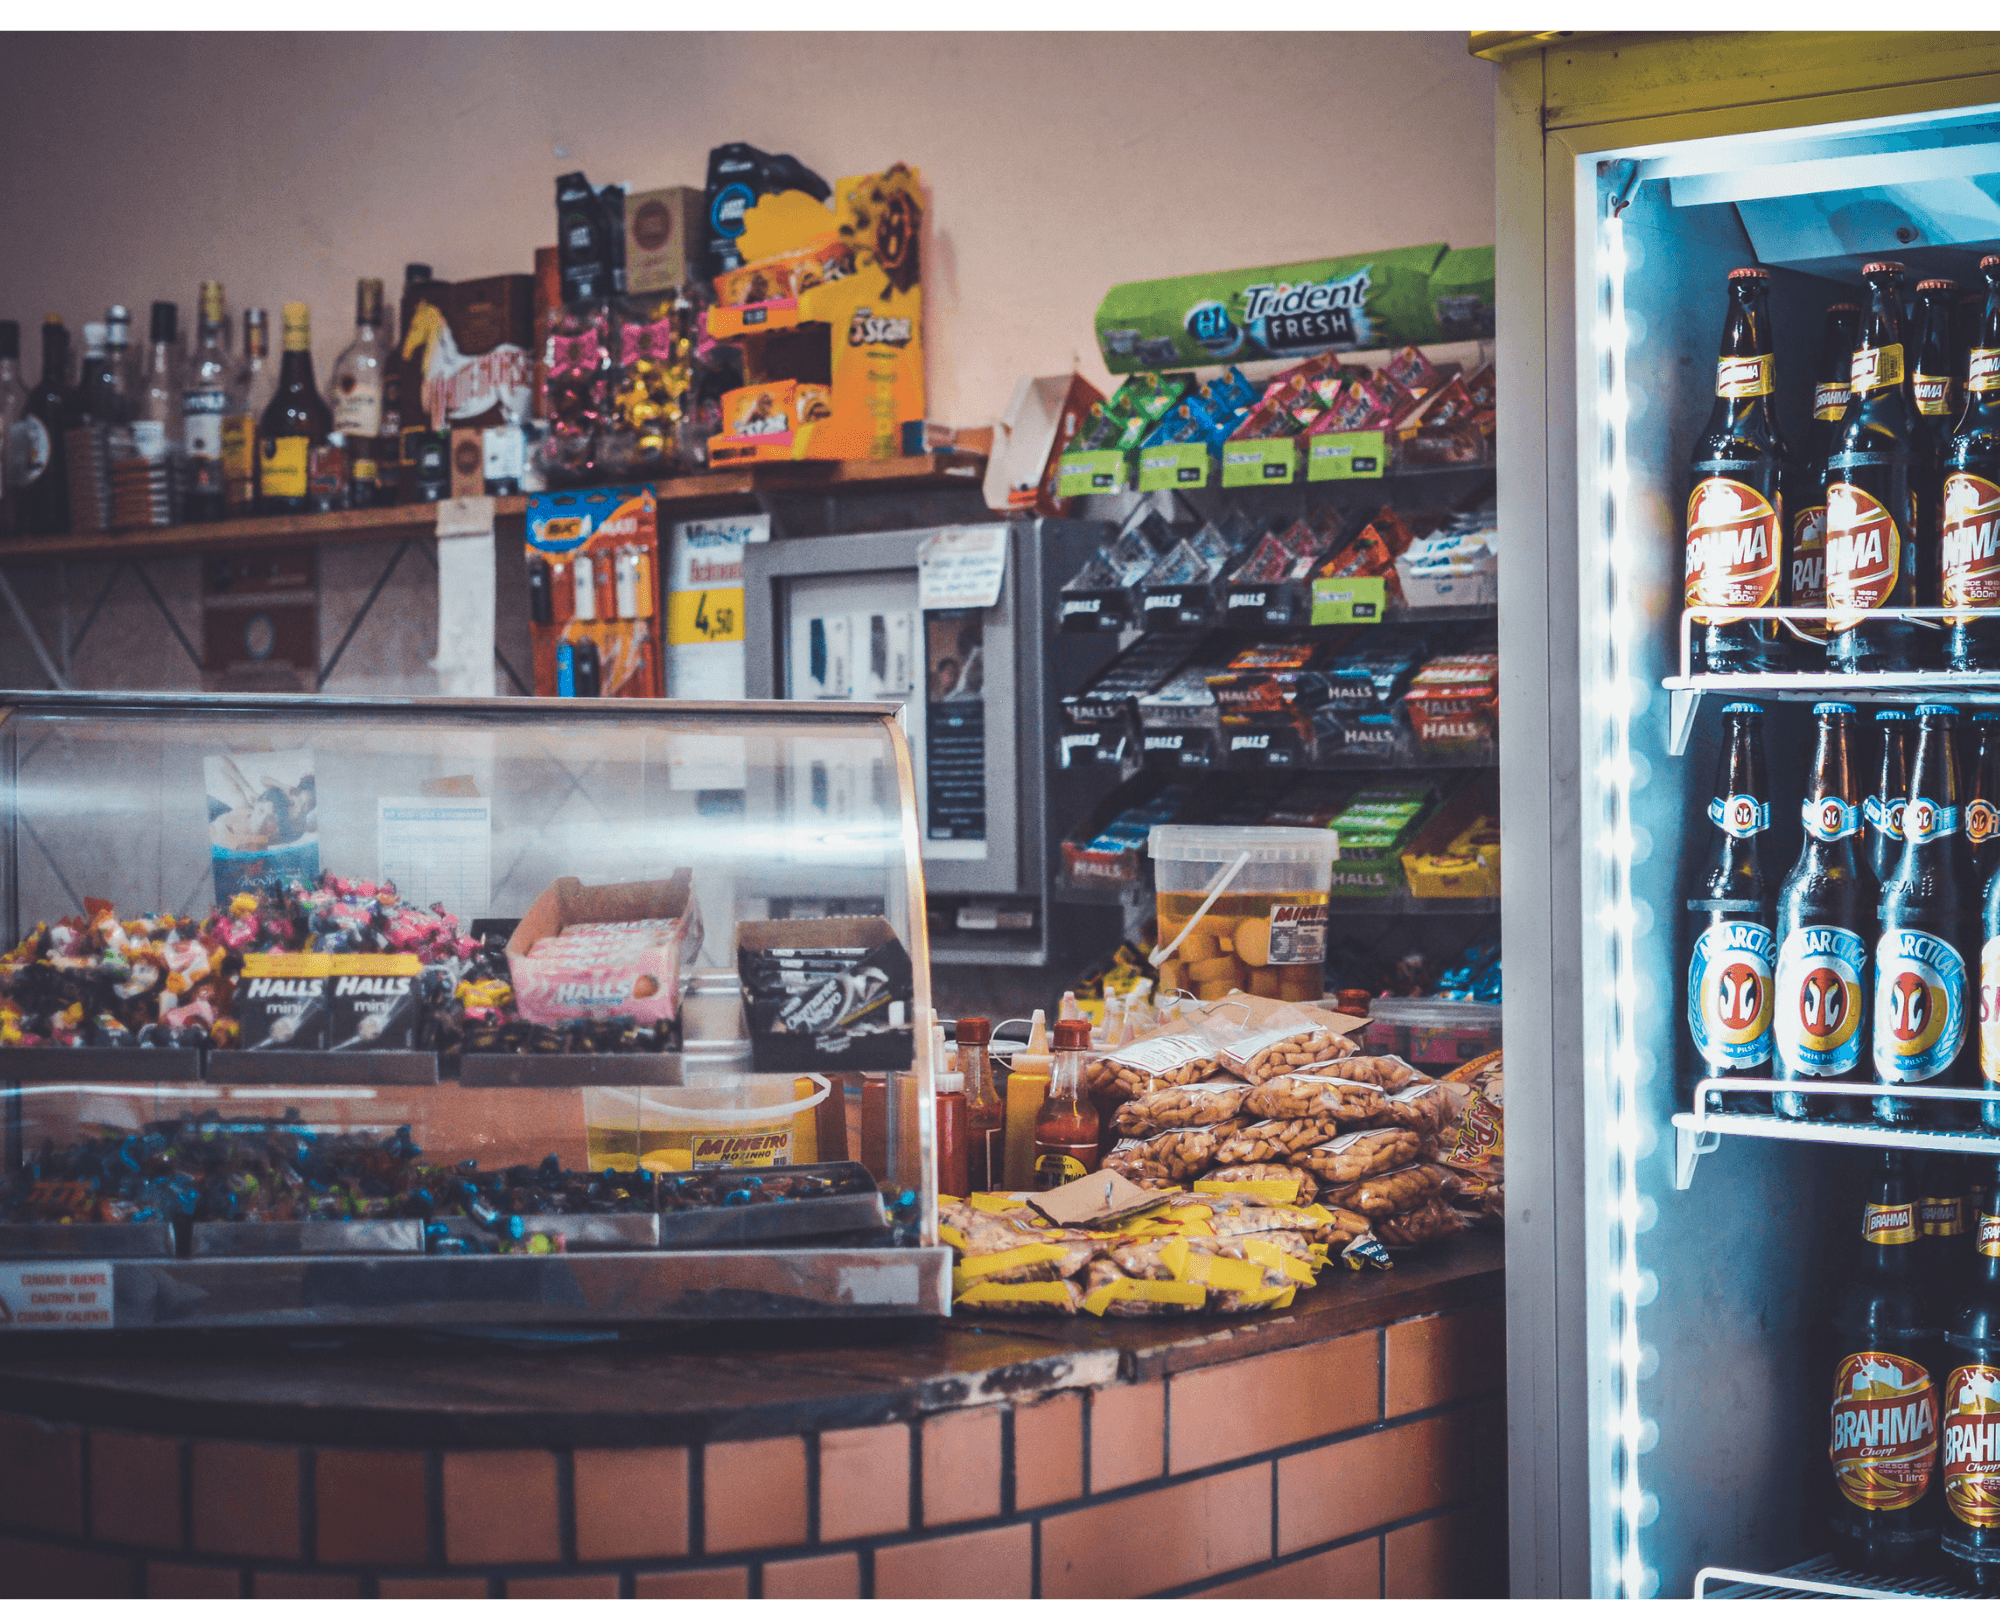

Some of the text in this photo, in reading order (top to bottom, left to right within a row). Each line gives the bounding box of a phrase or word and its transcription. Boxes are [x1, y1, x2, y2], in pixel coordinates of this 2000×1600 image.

[1246, 275, 1368, 322] Trident
[1271, 313, 1348, 341] FRESH
[1328, 686, 1373, 700] HALLS
[1344, 730, 1394, 744] HALLS
[1422, 722, 1478, 740] HALLS
[1331, 872, 1384, 886] HALLS
[247, 977, 324, 999] HALLS
[334, 976, 412, 997] HALLS
[555, 980, 631, 1004] HALLS
[354, 999, 391, 1013] mini
[786, 979, 839, 1031] Diamante
[805, 991, 842, 1033] Negro
[696, 1133, 788, 1157] MINEIRO
[1870, 1211, 1909, 1230] BRAHMA
[70, 1272, 107, 1286] QUENTE
[78, 1291, 97, 1303] HOT
[66, 1309, 110, 1322] CALIENTE
[1834, 1397, 1934, 1453] BRAHMA
[1859, 1446, 1897, 1458] Chopp
[1945, 1422, 2000, 1468] BRAH
[1906, 1474, 1926, 1482] litro
